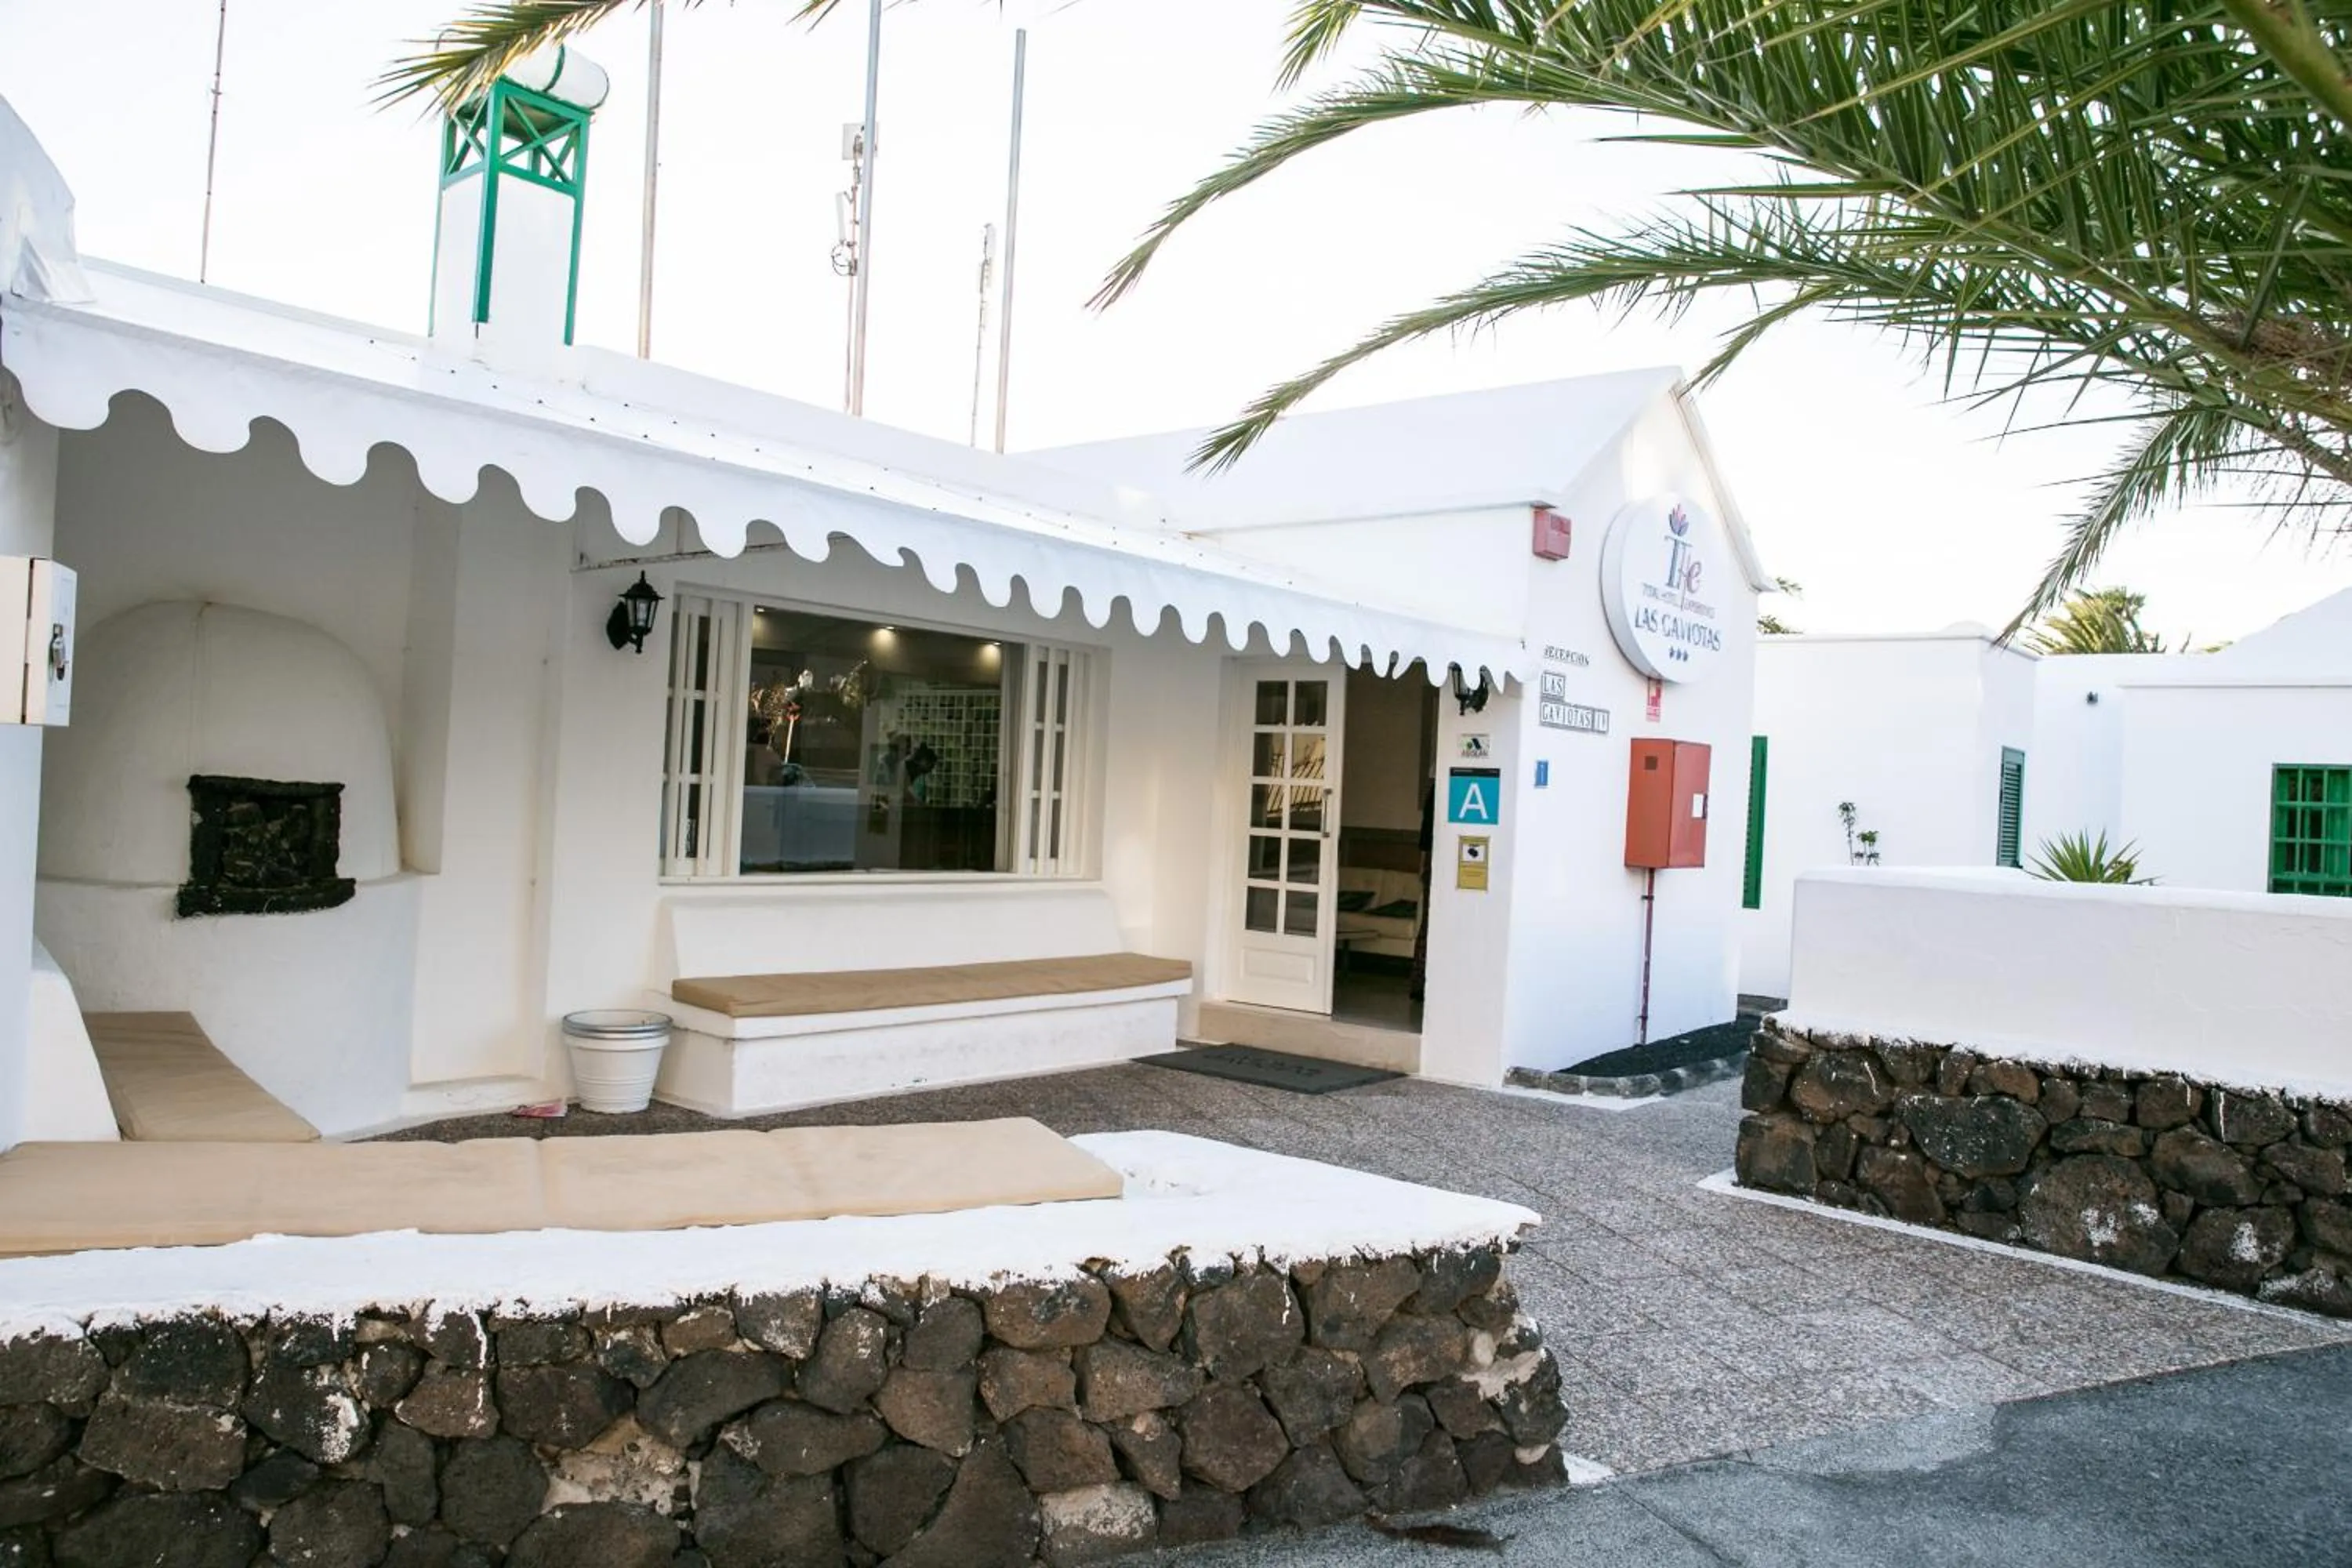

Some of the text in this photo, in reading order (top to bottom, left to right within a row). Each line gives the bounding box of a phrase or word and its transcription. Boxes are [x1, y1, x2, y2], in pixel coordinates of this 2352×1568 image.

[1635, 605, 1721, 652] LAS GAVIOTAS
[1544, 674, 1563, 694] LAS
[1542, 702, 1592, 728] GAVIOTAS
[1458, 782, 1489, 820] A
